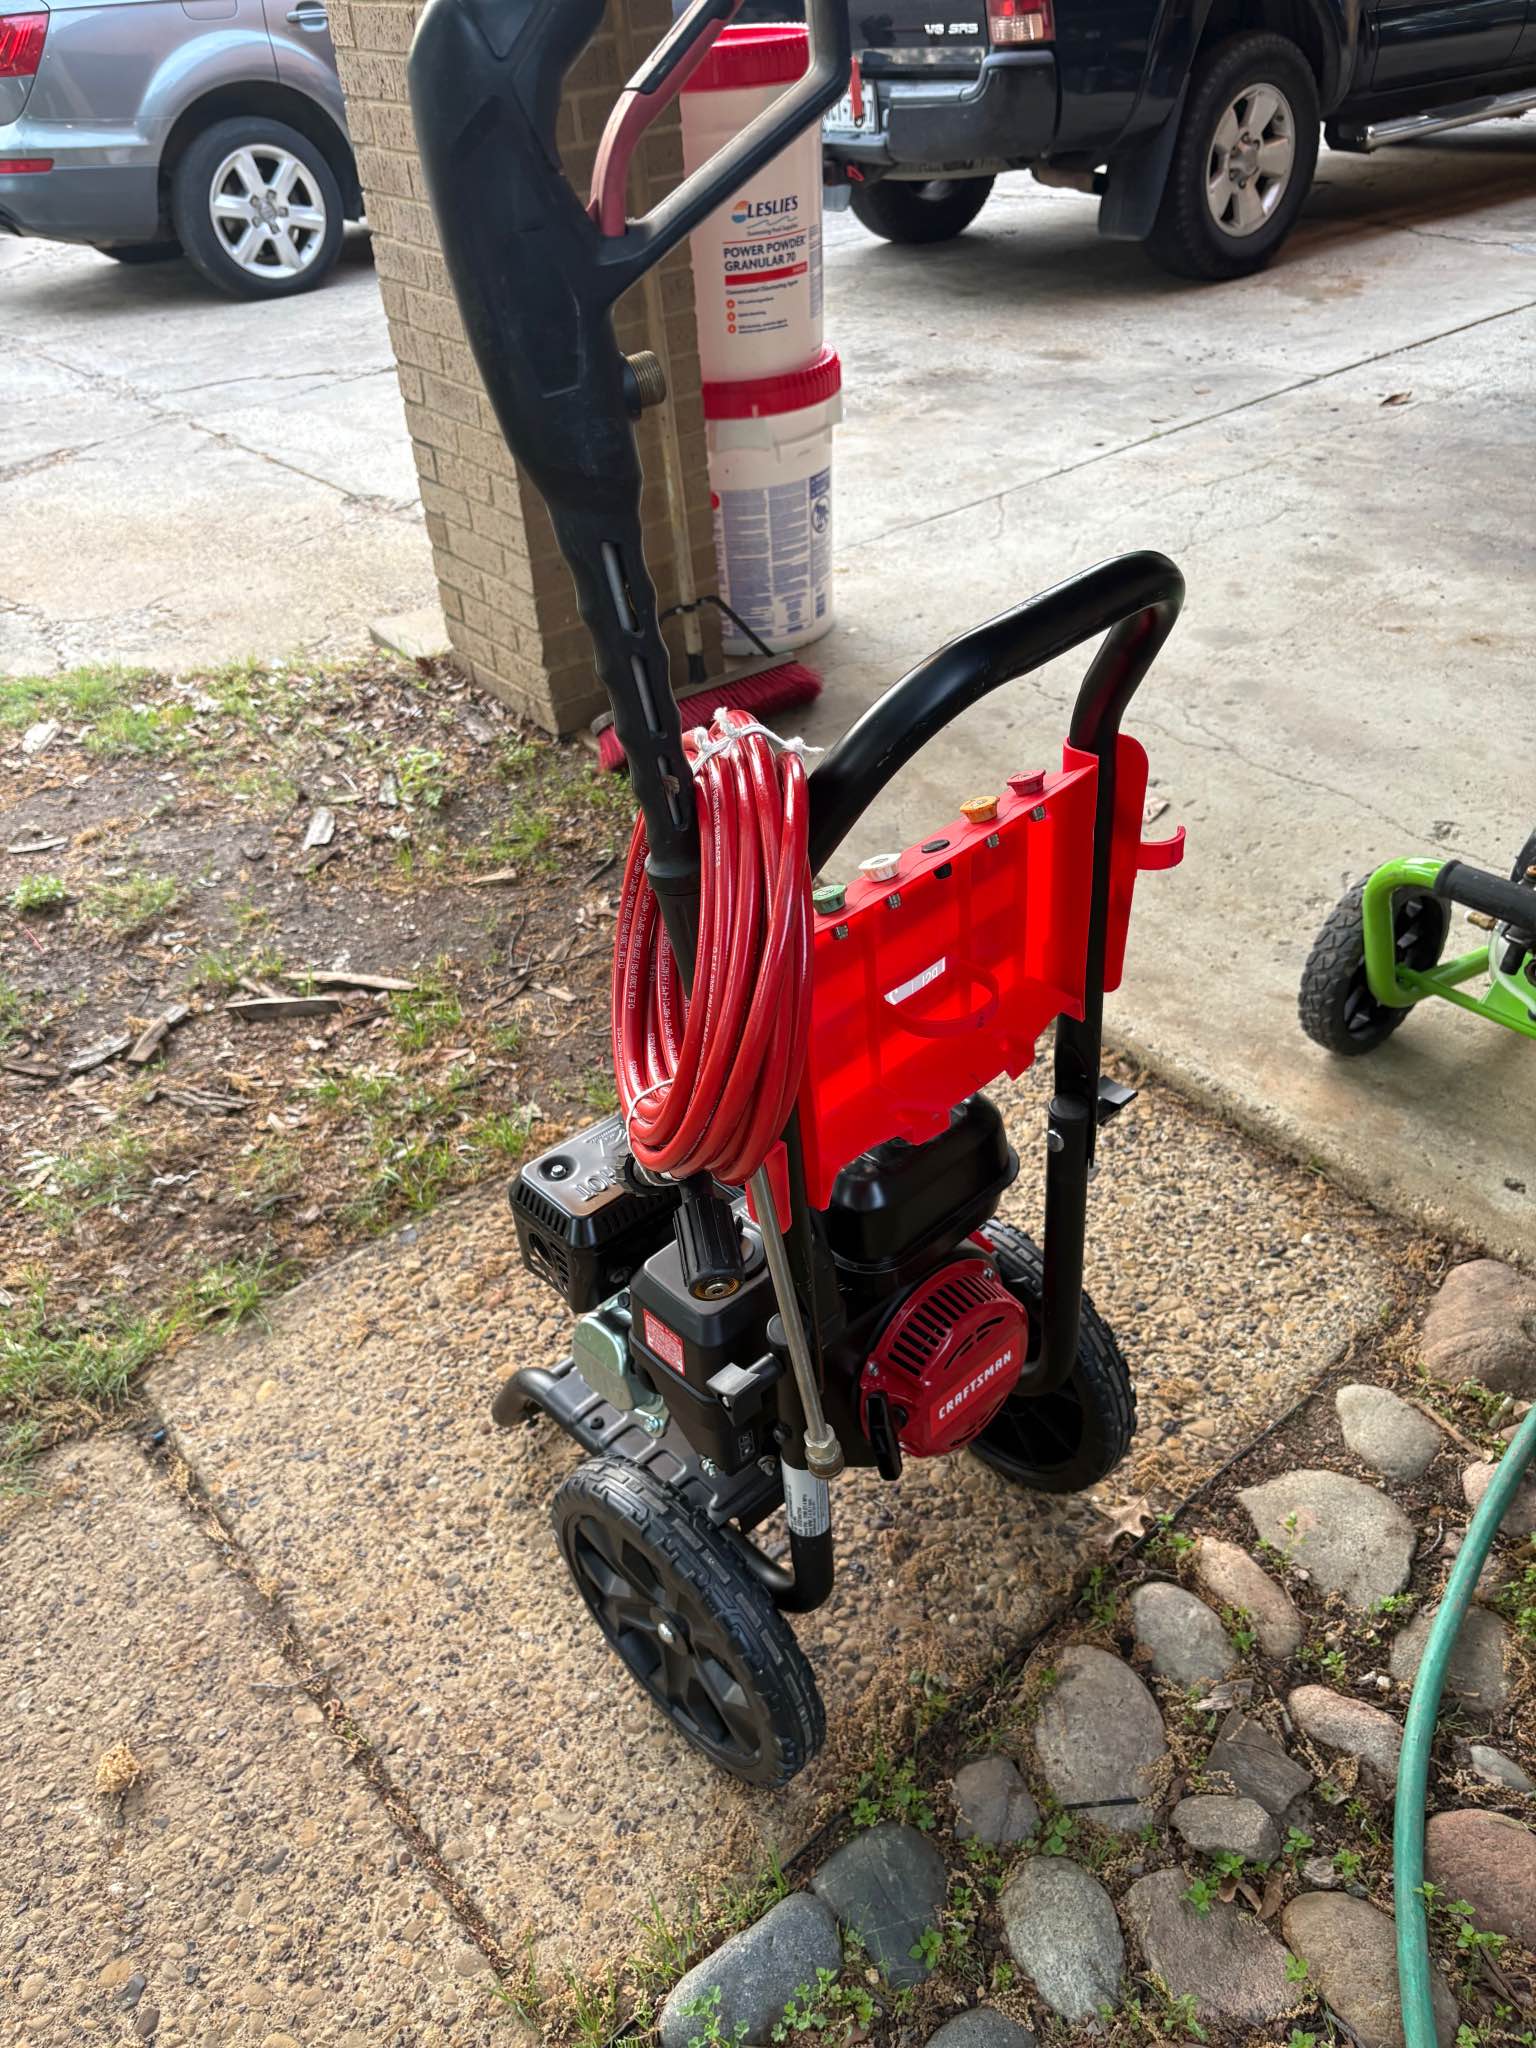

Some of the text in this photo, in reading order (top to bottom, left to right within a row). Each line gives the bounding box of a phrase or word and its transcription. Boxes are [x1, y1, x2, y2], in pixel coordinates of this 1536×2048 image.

[723, 236, 805, 259] POWER POWDER
[724, 254, 785, 272] GRANULAR
[634, 934, 642, 947] BAR
[630, 963, 639, 974] PSI
[939, 1350, 1011, 1419] CRAFTSMAN
